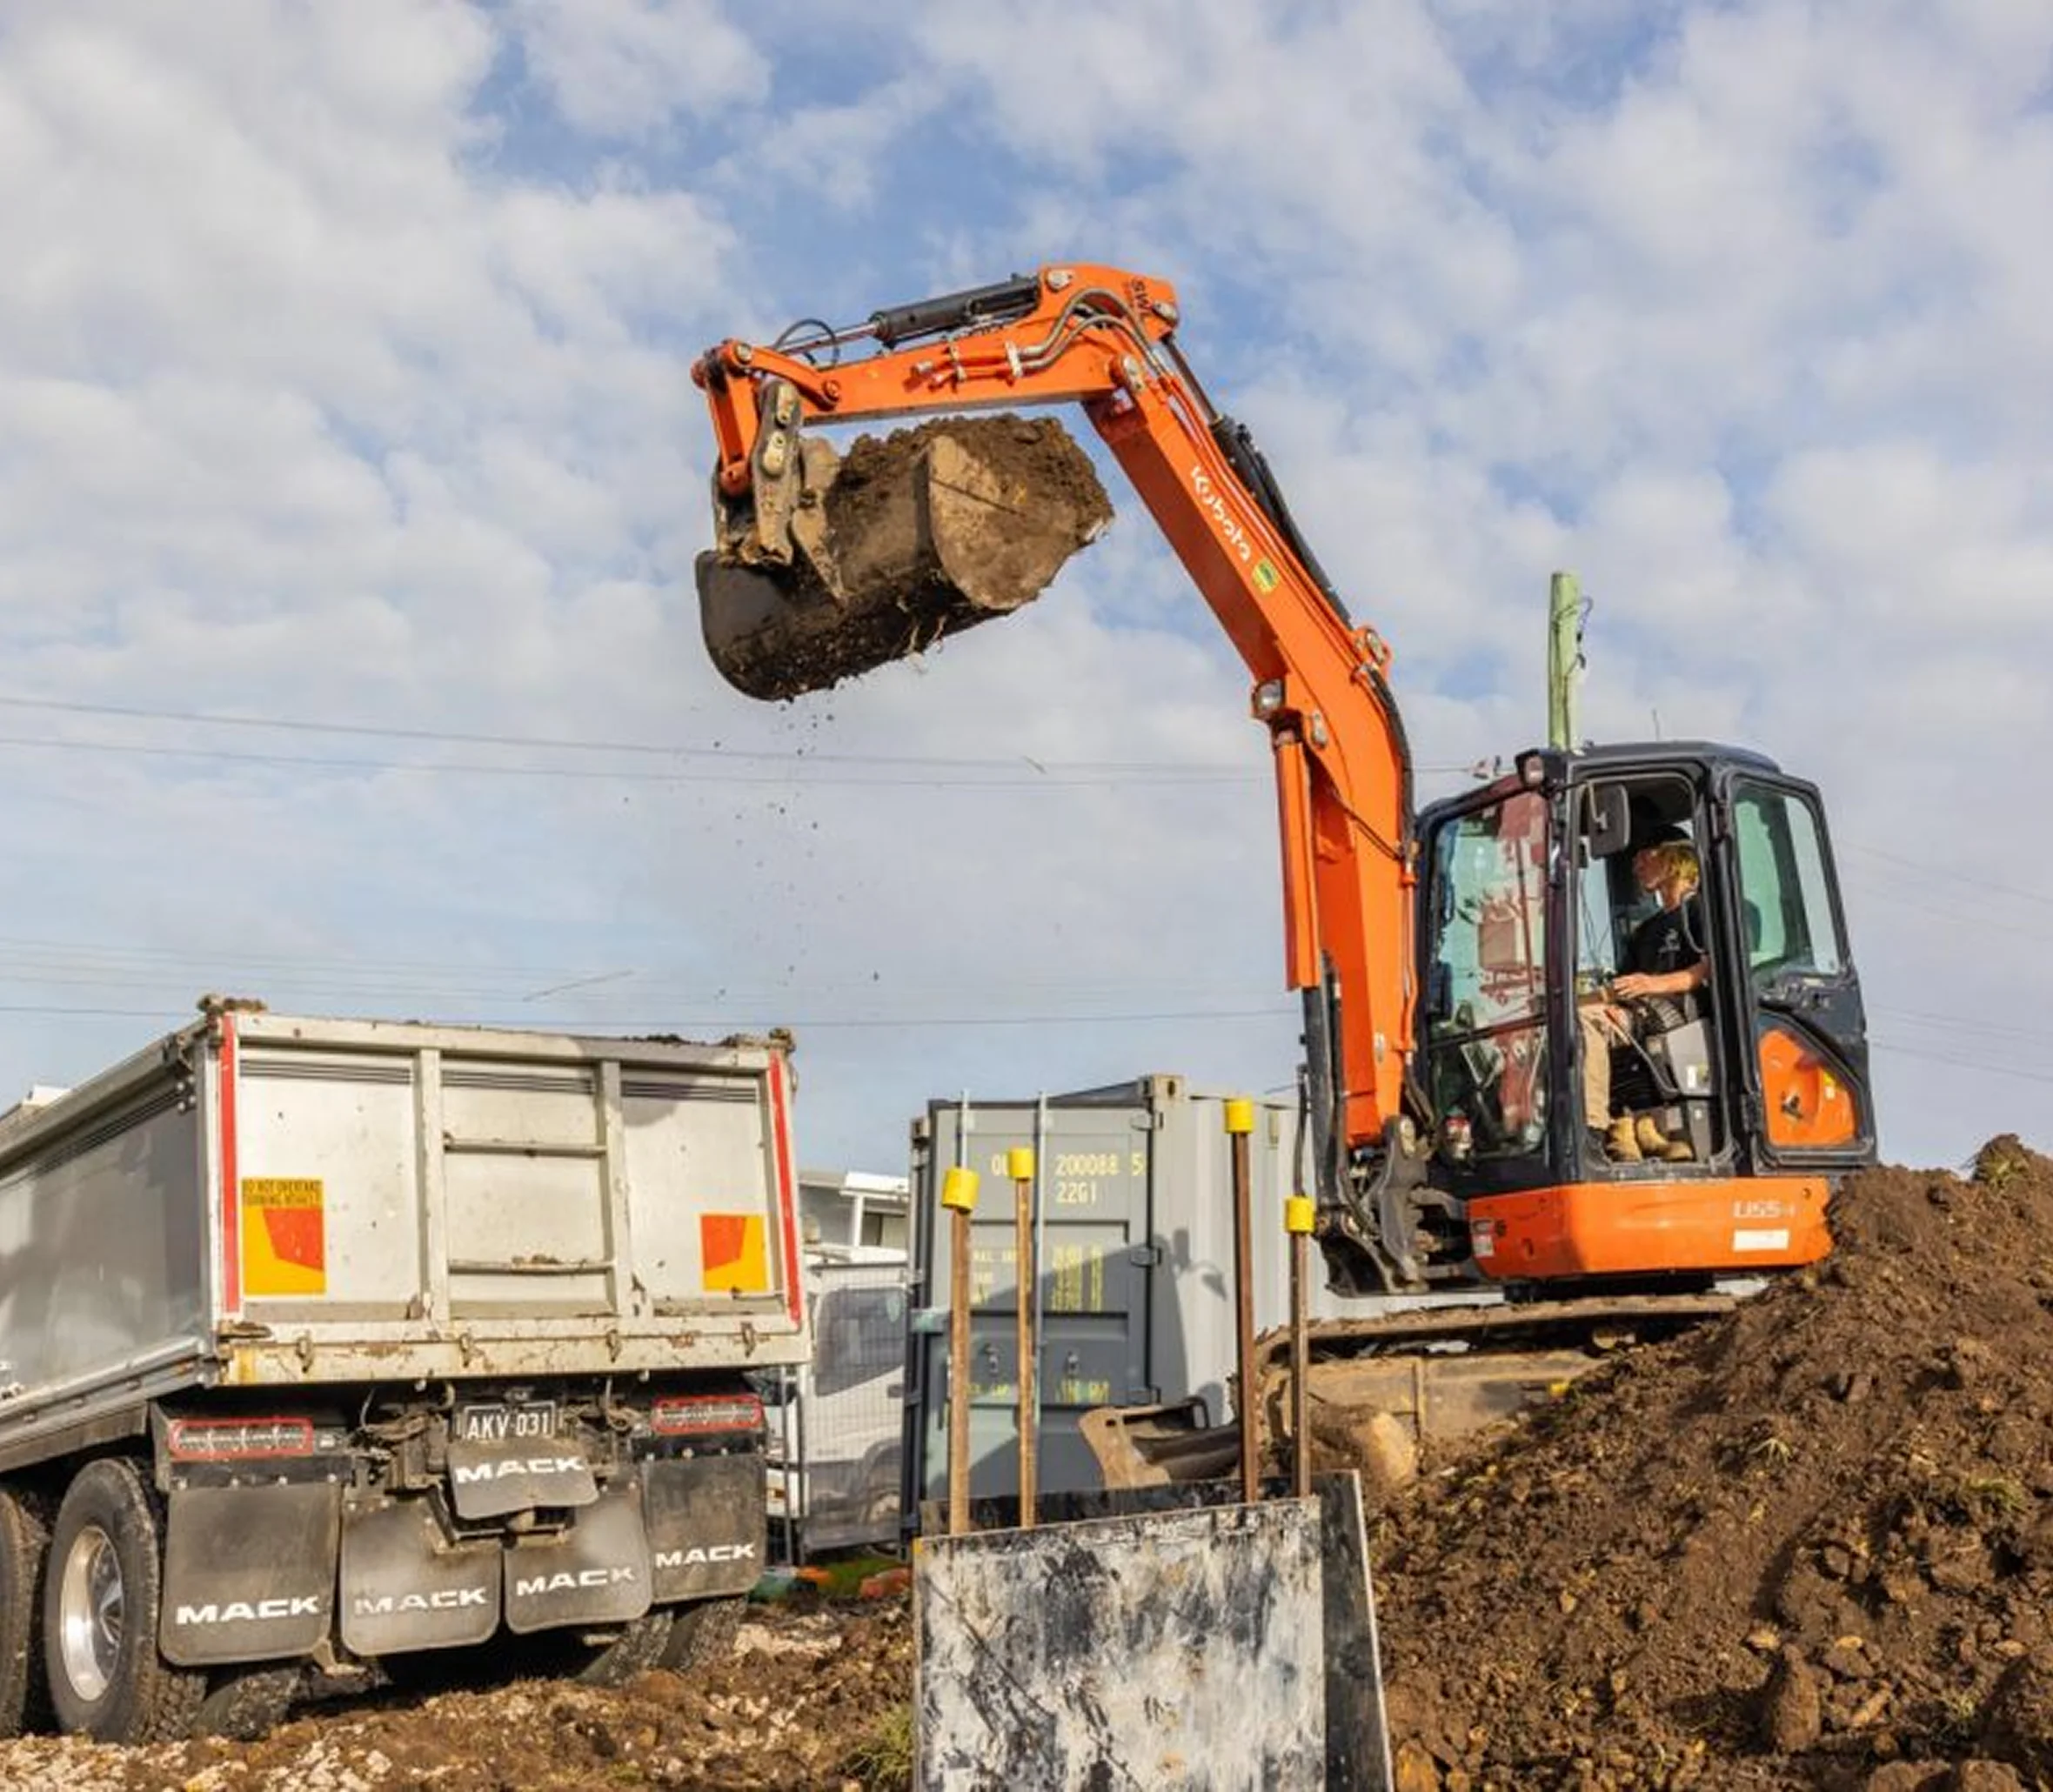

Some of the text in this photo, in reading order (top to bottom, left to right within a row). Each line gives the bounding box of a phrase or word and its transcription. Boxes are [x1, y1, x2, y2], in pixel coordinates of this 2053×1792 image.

[1191, 465, 1251, 561] Kubota
[1132, 1153, 1144, 1177] 5
[515, 1412, 558, 1437] 031
[455, 1456, 585, 1484] MACK
[655, 1543, 756, 1568] MACK
[516, 1567, 635, 1596] MACK
[176, 1595, 320, 1625] MACK
[354, 1587, 487, 1615] MACK
